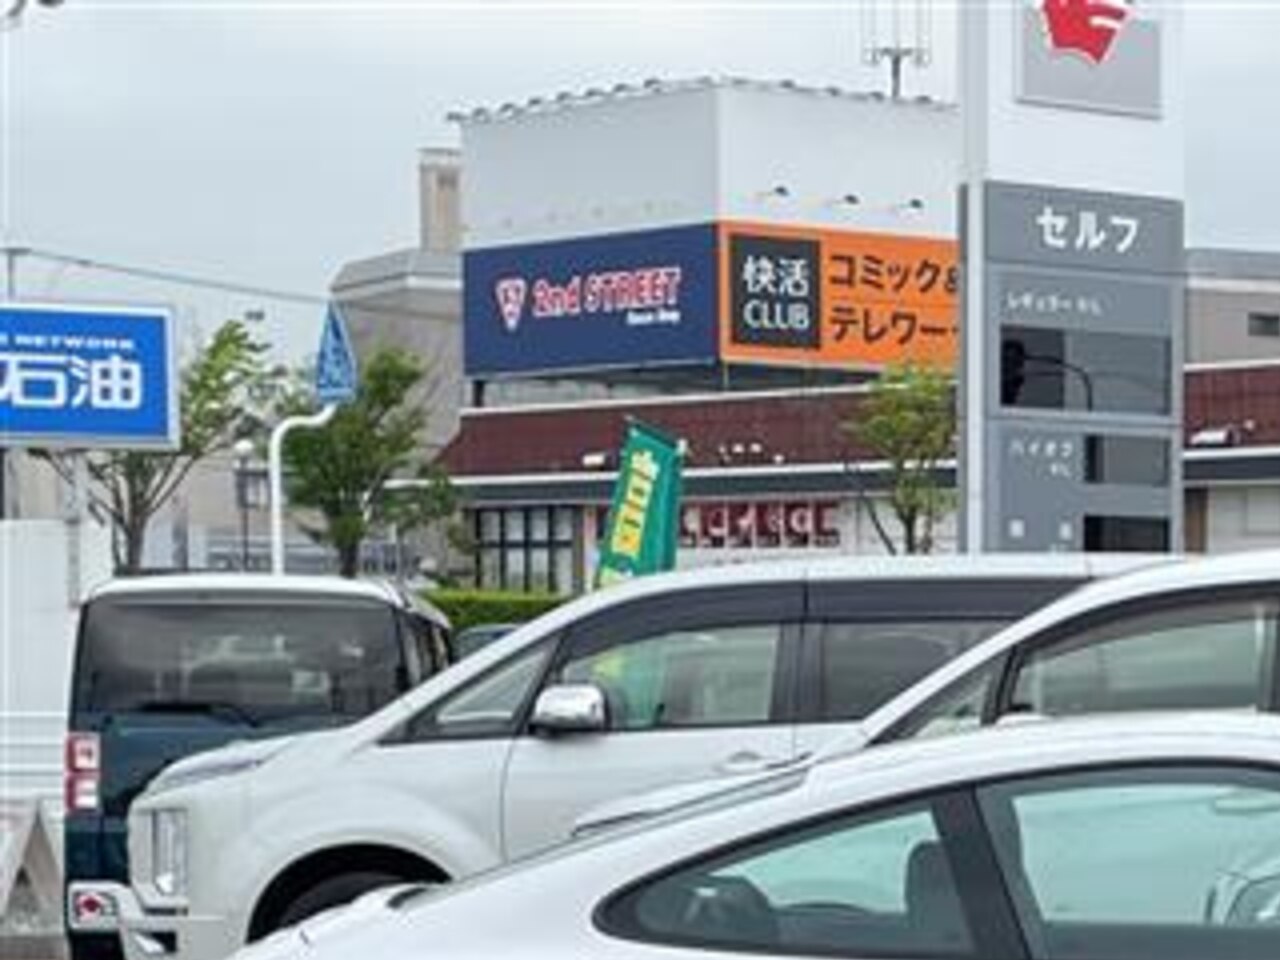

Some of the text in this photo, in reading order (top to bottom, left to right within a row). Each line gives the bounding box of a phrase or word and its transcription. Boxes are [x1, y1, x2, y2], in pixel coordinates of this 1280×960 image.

[1036, 206, 1139, 253] セルフ
[533, 267, 682, 317] 2nd STREET
[743, 255, 810, 297] 快活
[743, 300, 810, 329] CLUB
[829, 306, 959, 345] テレワー
[0, 352, 142, 409] 石油
